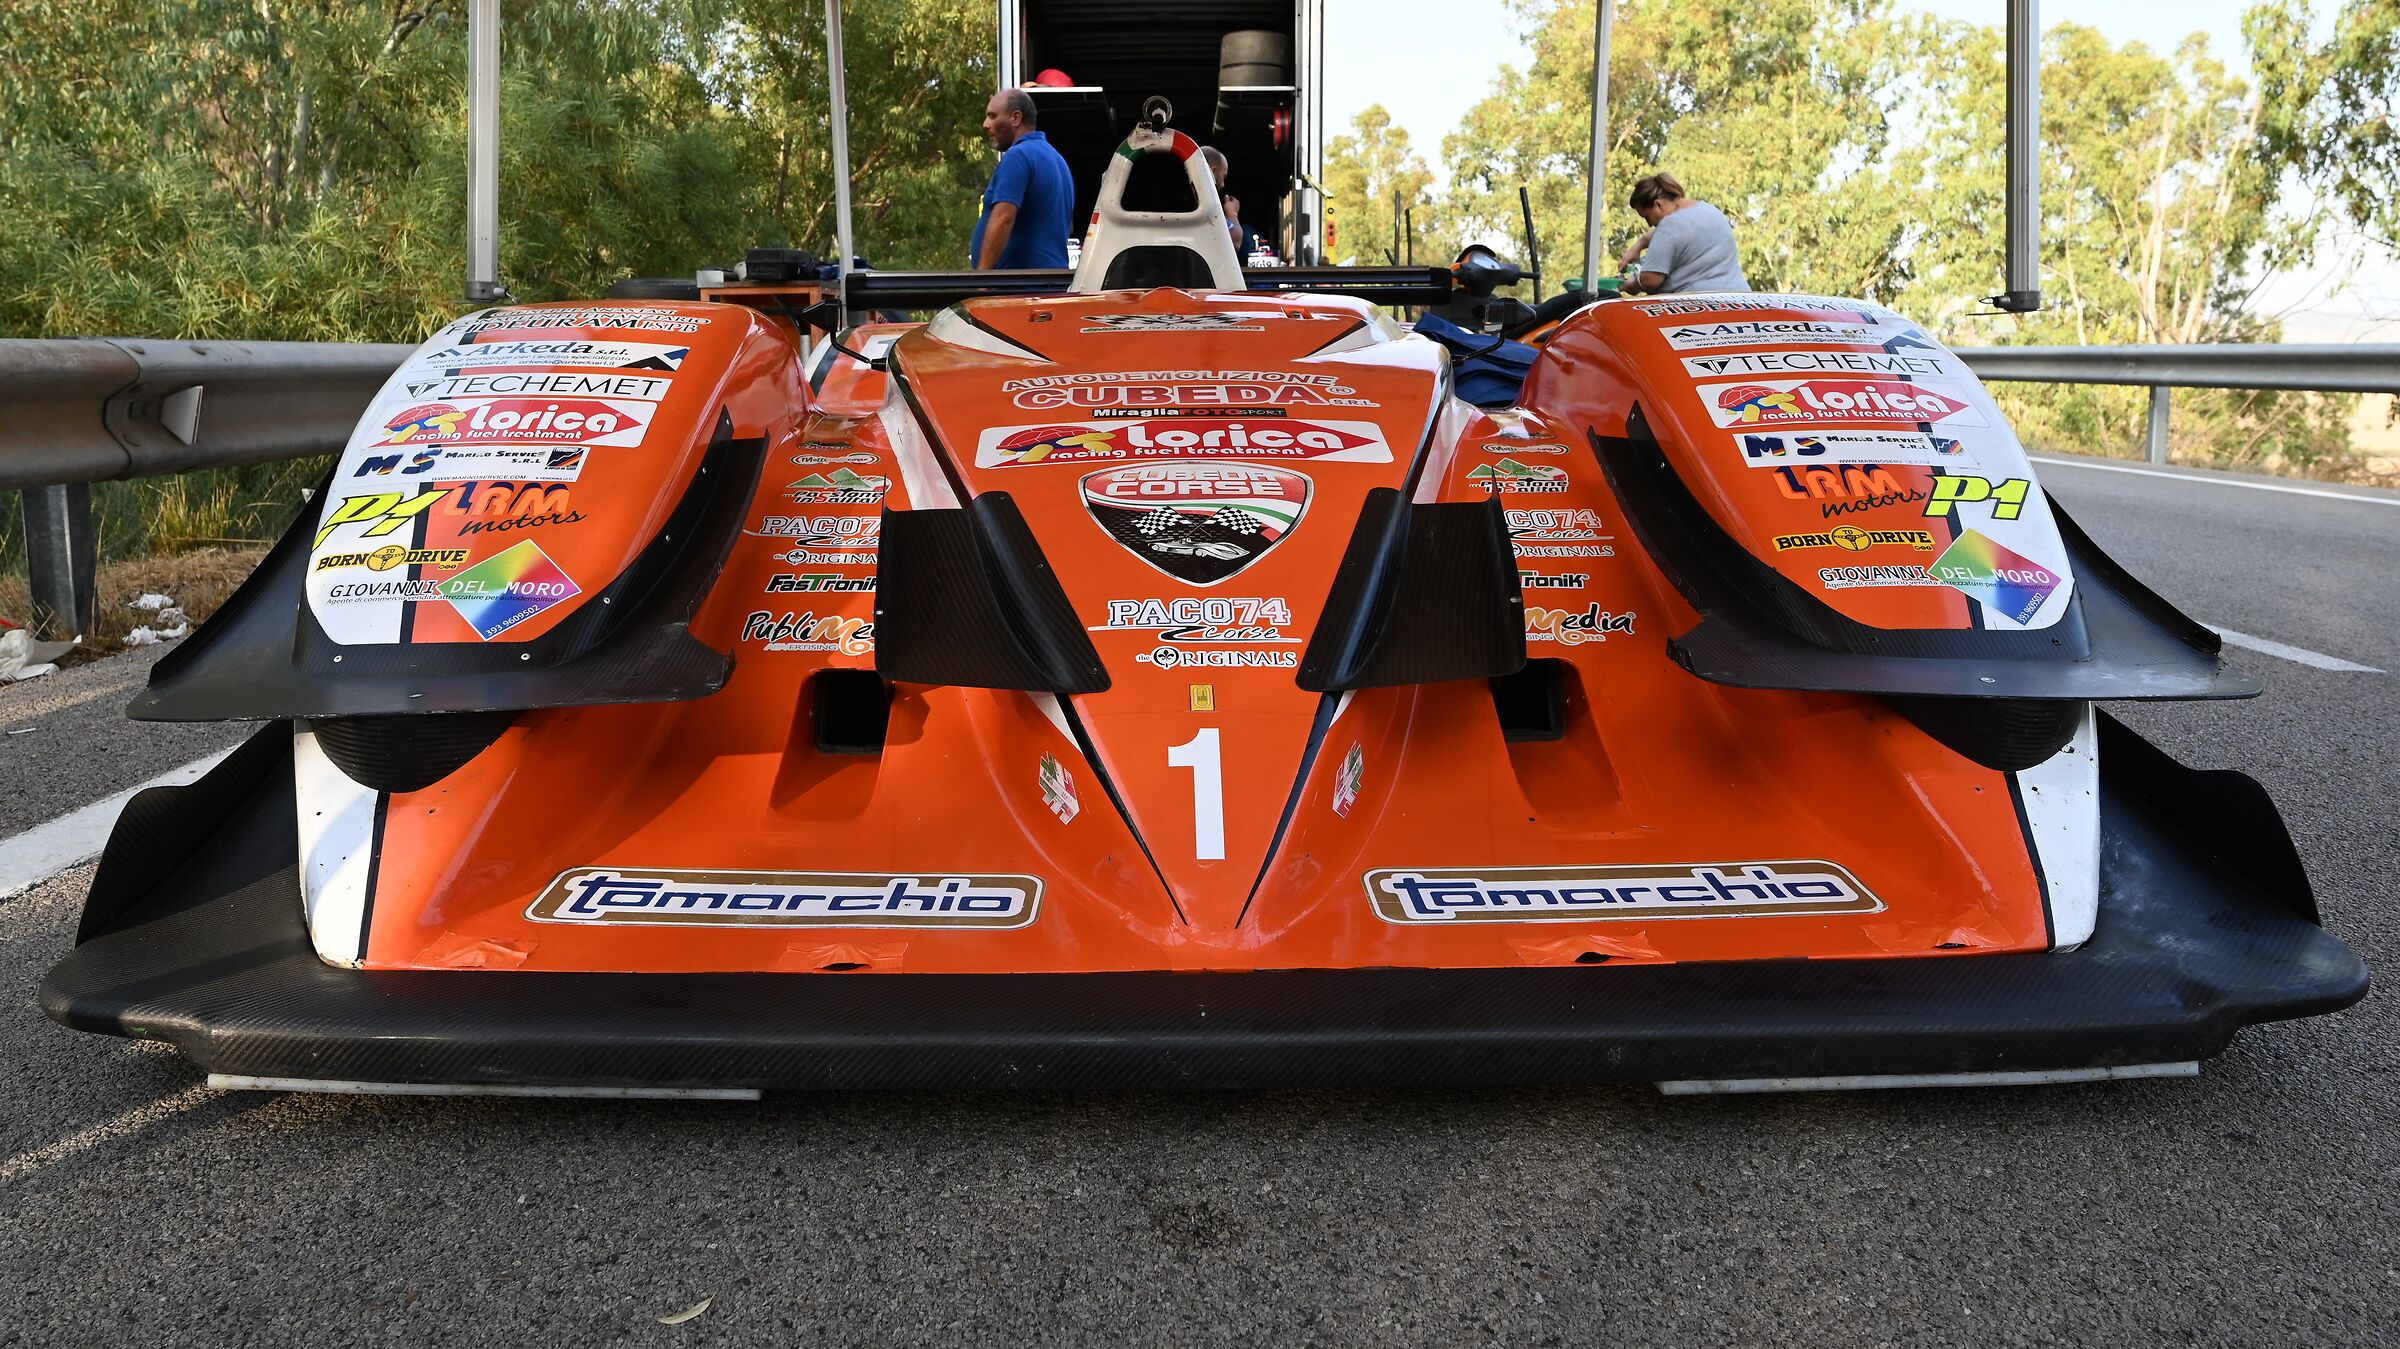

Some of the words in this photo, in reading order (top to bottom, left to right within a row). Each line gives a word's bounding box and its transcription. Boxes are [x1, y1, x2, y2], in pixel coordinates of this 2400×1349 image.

[445, 319, 637, 335] FIDEURAM
[641, 321, 697, 333] ISPB
[1711, 322, 1836, 335] Arkeda
[464, 342, 594, 356] Arkeda
[1734, 354, 1944, 374] TECHEMET
[446, 376, 663, 396] TECHEMET
[1004, 372, 1338, 390] AUTODEMOLIZIONE
[1016, 386, 1327, 409] CUBEDA
[1798, 386, 1951, 413] Lorica
[470, 405, 618, 432] Lorica
[1762, 410, 1814, 421] racing
[1817, 409, 1849, 419] fuel
[1853, 409, 1930, 419] treatment
[411, 430, 461, 441] racing
[467, 429, 501, 440] fuel
[503, 429, 583, 440] treatment
[1128, 424, 1344, 449] Lorica
[1050, 447, 1126, 460] racing
[1135, 446, 1179, 456] fuel
[1188, 446, 1306, 457] treatment
[1112, 470, 1277, 482] CUBEDA
[1773, 465, 1906, 500] LRM
[1106, 481, 1284, 496] CORSE
[1923, 474, 2030, 520] P1
[443, 482, 571, 516] LRM
[1823, 488, 1926, 519] motors
[458, 509, 586, 537] motors
[761, 516, 881, 535] PACO7
[1504, 510, 1603, 528] CO74
[1775, 533, 1831, 550] BORN
[1869, 530, 1931, 545] DRIVE
[316, 553, 369, 571] BORN
[404, 550, 467, 563] DRIVE
[786, 550, 878, 565] ORIGINA
[1820, 566, 1928, 582] GIOVANNI
[1940, 567, 1983, 580] DEL
[1991, 568, 2050, 584] MORO
[330, 581, 436, 598] GIOVANNI
[450, 580, 489, 594] DEL
[504, 581, 566, 596] MORO
[327, 598, 354, 606] Agente
[485, 624, 503, 637] 393
[502, 604, 541, 627] 9609502
[1108, 599, 1291, 627] PACO74
[2017, 610, 2029, 624] 393
[1154, 647, 1297, 668] ORIGINALS
[1168, 727, 1225, 860] 1
[574, 872, 1013, 915] tomarchio
[1393, 868, 1845, 915] tomarchio
